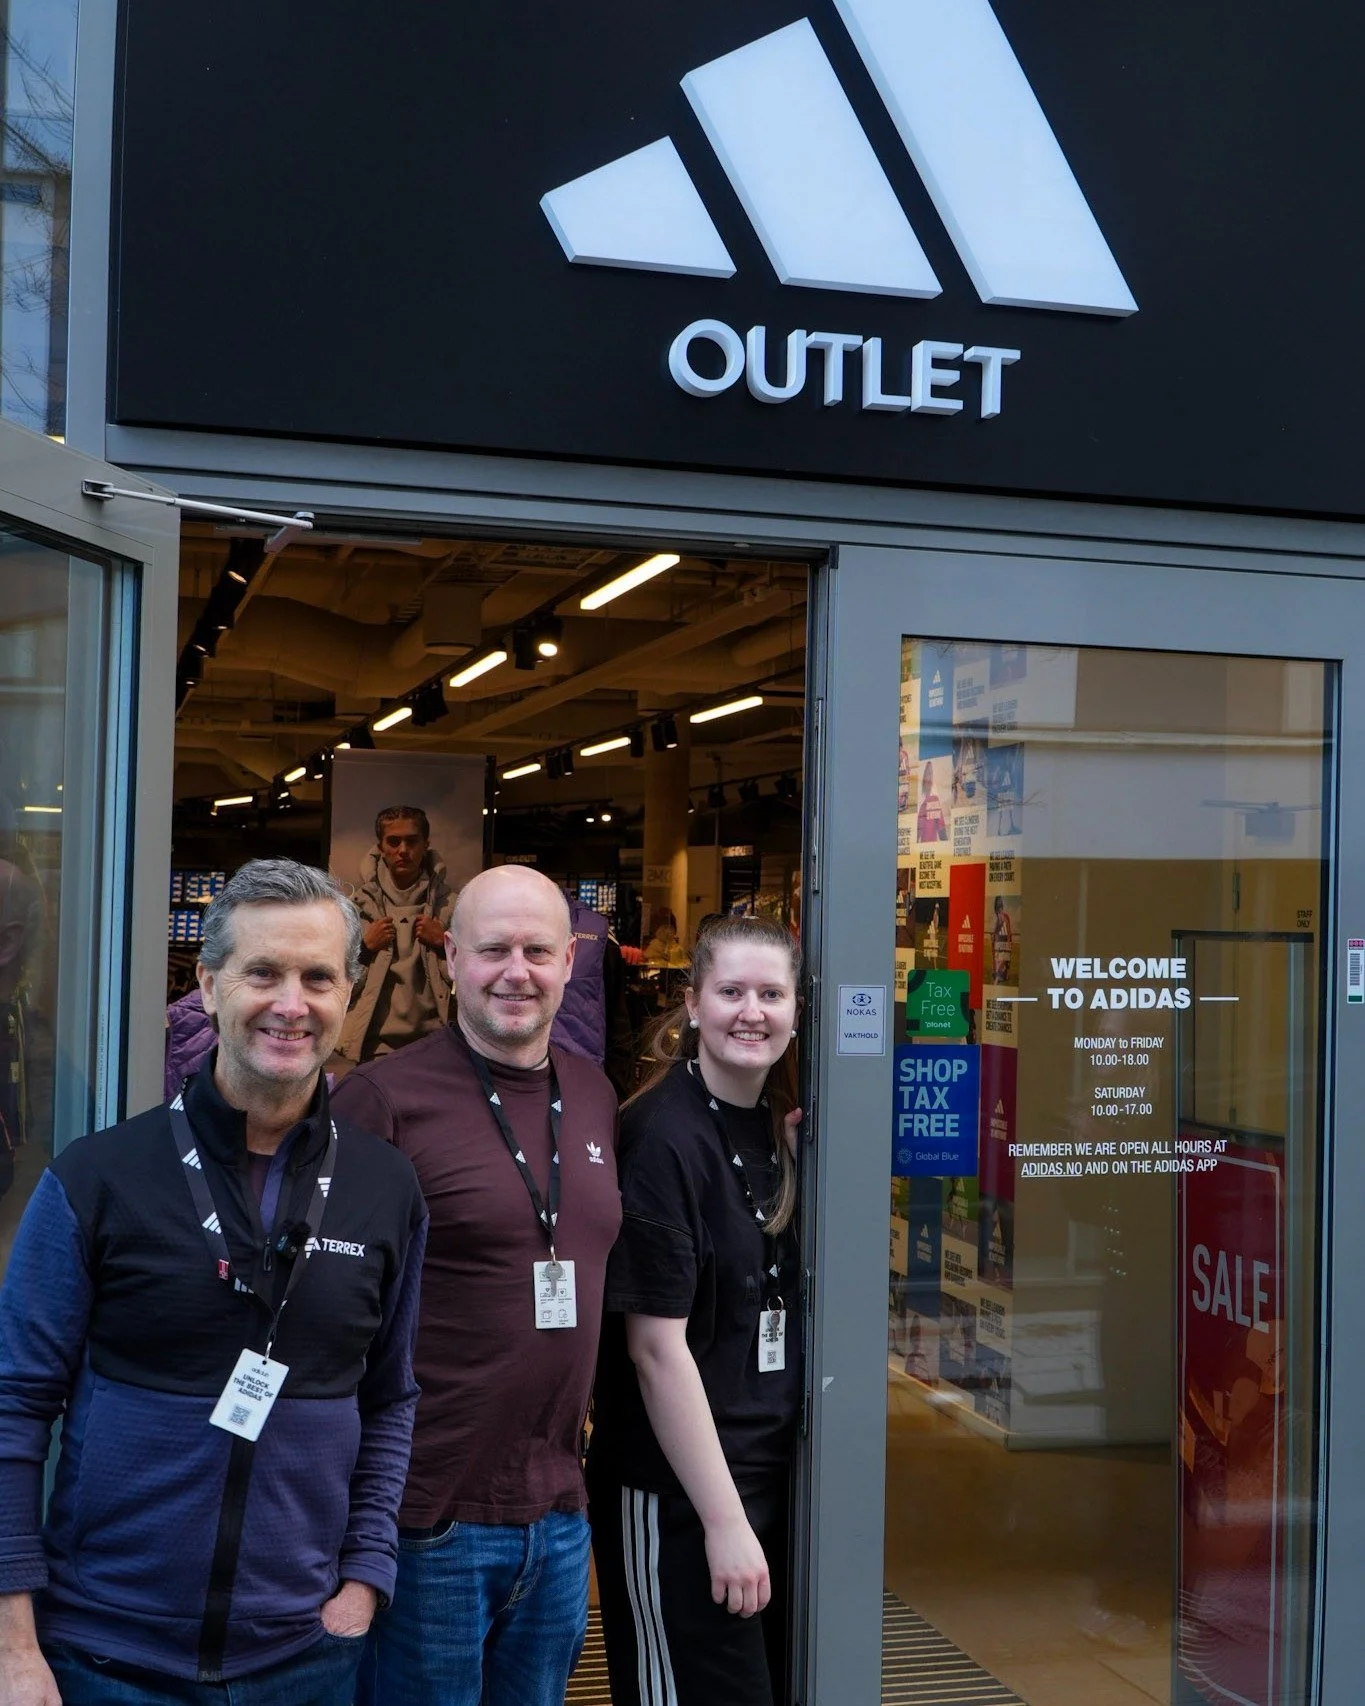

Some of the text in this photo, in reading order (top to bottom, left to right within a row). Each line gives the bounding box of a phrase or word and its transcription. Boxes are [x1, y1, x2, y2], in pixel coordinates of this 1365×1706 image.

[668, 318, 1021, 419] OUTLET
[1297, 910, 1312, 918] STAFF
[1297, 920, 1310, 928] ONLY
[1050, 958, 1186, 979] WELCOME
[926, 982, 952, 998] Tax
[1047, 988, 1191, 1009] TO ADIDAS
[921, 1000, 955, 1016] Free
[1074, 1037, 1164, 1049] MONDAY to FRIDAY
[1090, 1054, 1149, 1066] 10.00-18.00
[900, 1058, 968, 1082] SHOP
[899, 1086, 950, 1110] TAX
[1094, 1087, 1146, 1099] SATURDAY
[1091, 1103, 1152, 1116] 10.00-17.00
[898, 1114, 960, 1137] FREE
[916, 1152, 959, 1161] Global Blue
[1008, 1140, 1228, 1157] REMEMBER WE ARE OPEN ALL HOURS AT
[1021, 1159, 1218, 1176] ADIDAS.NO AND ON THE ADIDAS APP
[322, 1238, 366, 1257] TERREX
[1192, 1243, 1270, 1334] SALE
[233, 1377, 246, 1386] THE
[246, 1383, 263, 1394] BEST
[243, 1374, 270, 1390] UNLOCK
[238, 1388, 262, 1401] ADIDAS
